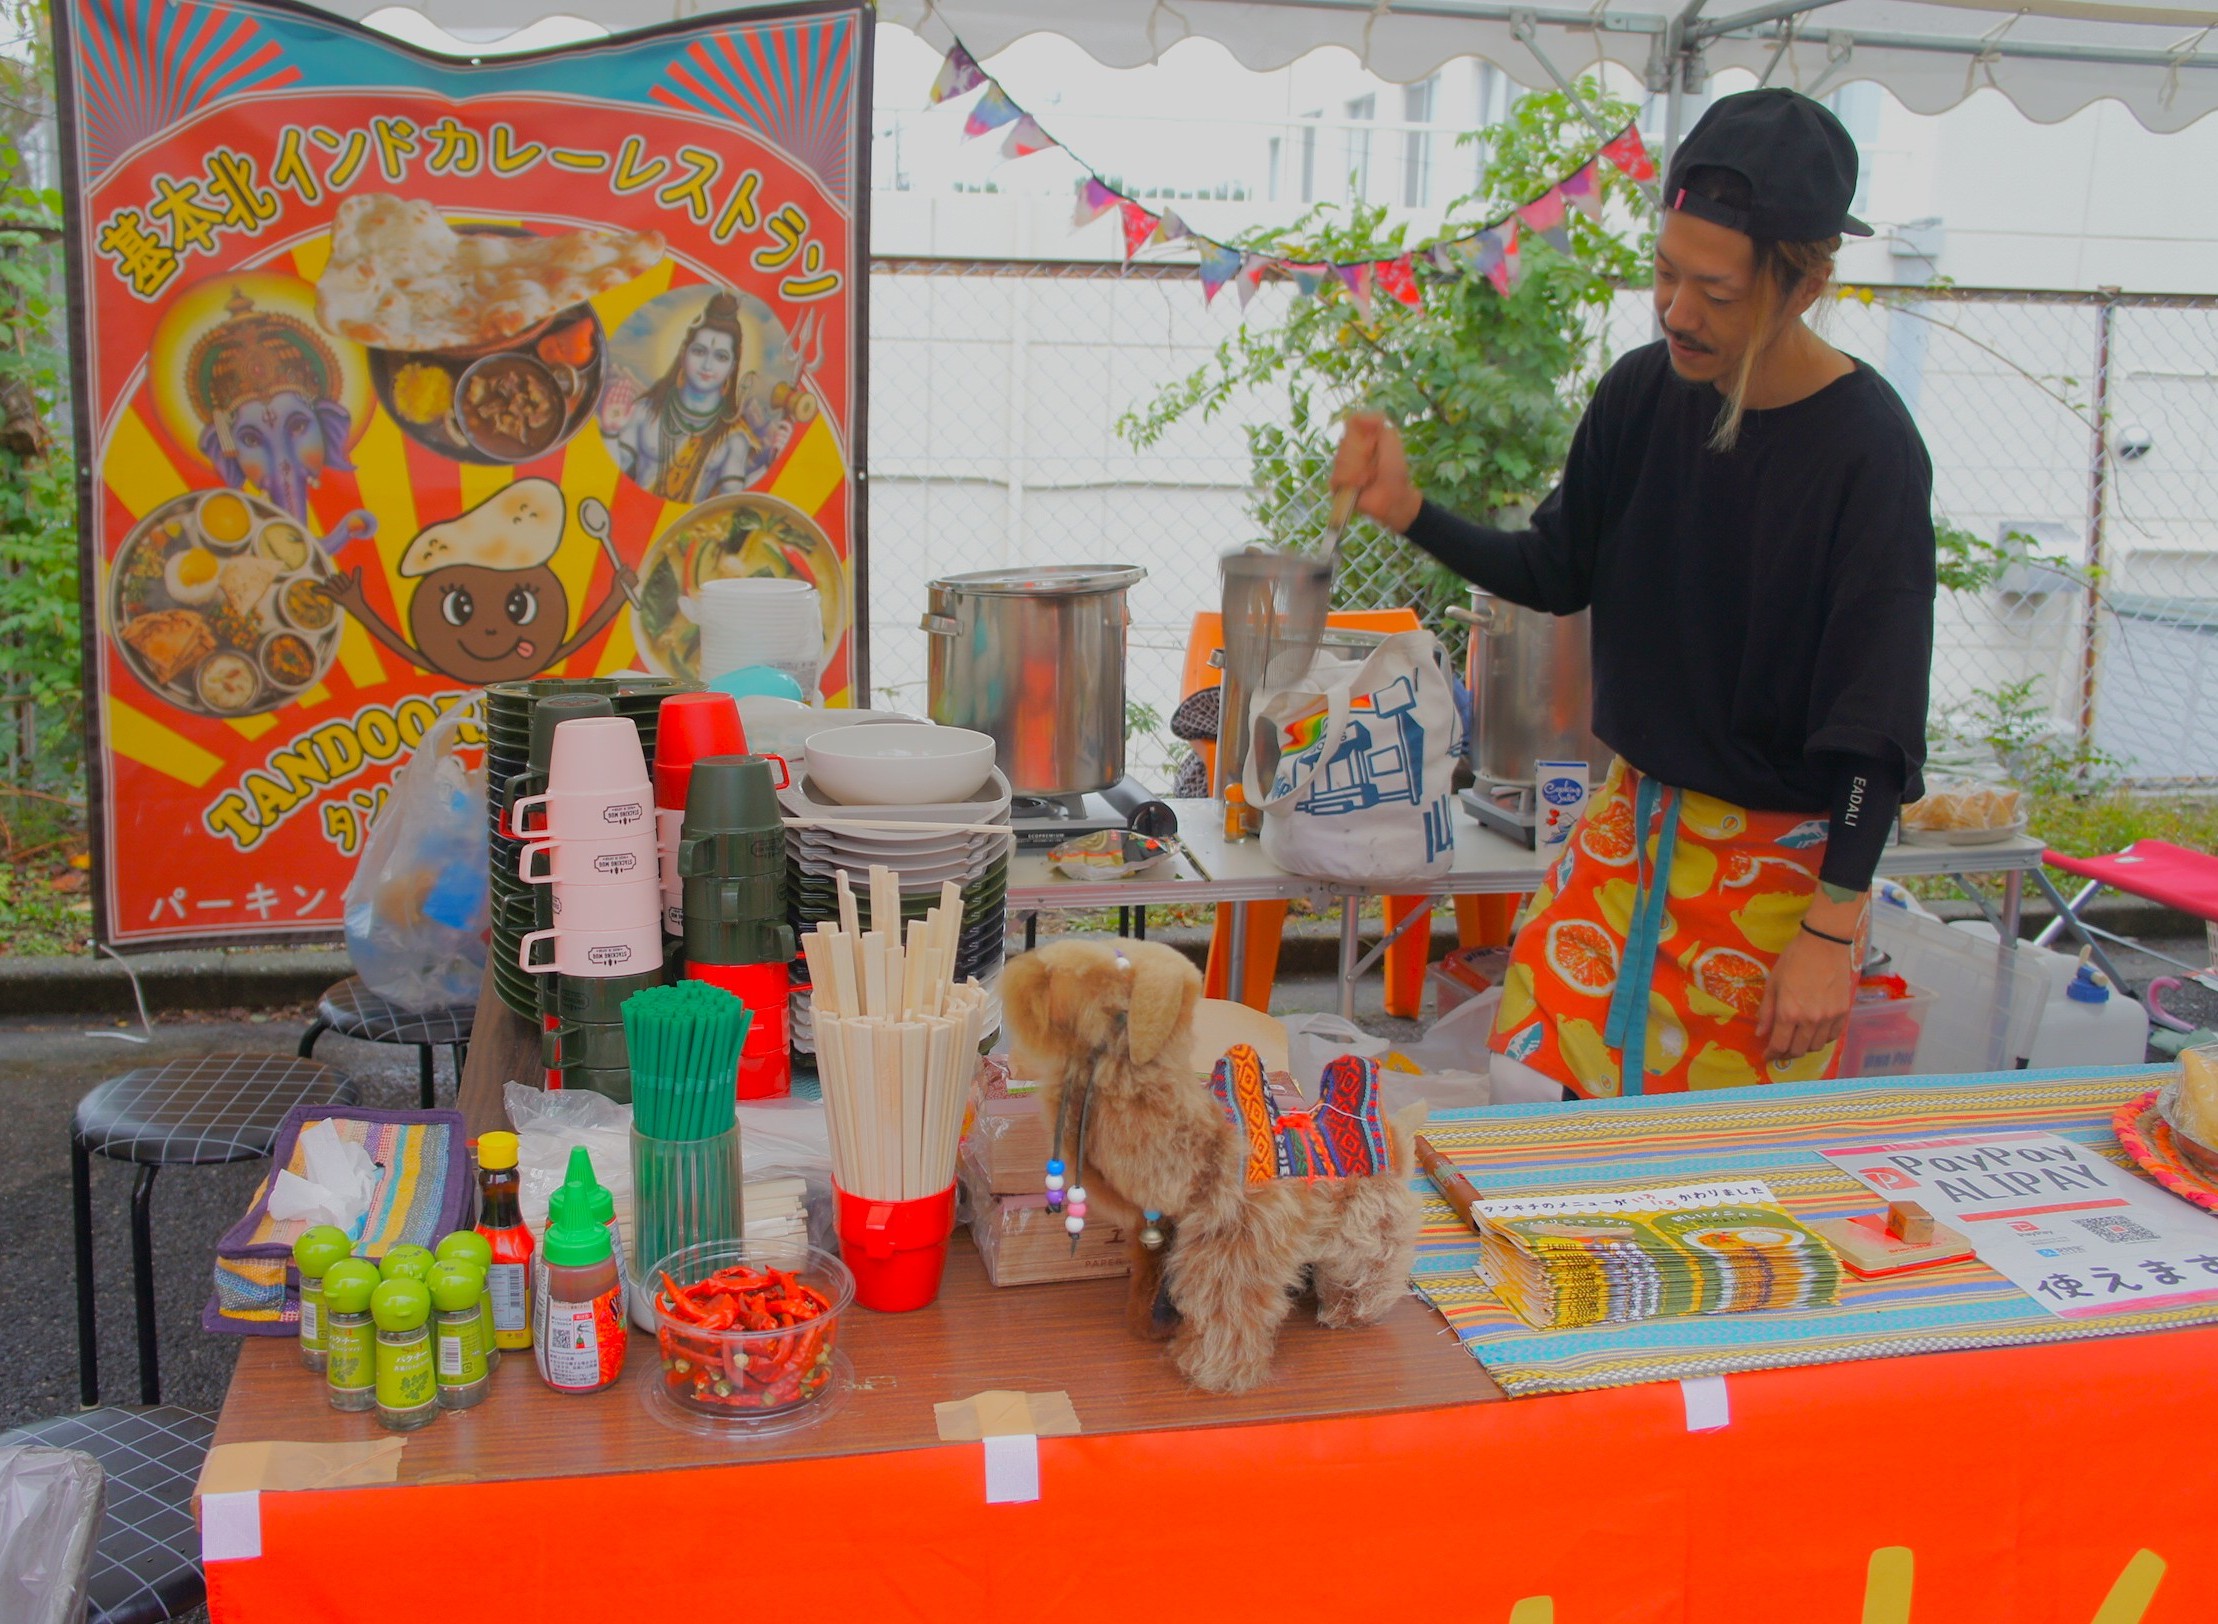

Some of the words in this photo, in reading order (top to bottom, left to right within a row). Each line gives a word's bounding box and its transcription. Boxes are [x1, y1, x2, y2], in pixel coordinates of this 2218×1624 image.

[99, 117, 840, 299] 基本北インドカレーレストラン
[205, 691, 487, 848] TANDOOR
[1844, 776, 1867, 827] EADALI
[149, 882, 344, 922] パーキン
[1887, 1145, 2078, 1177] PayPay
[1934, 1164, 2109, 1203] ALIPAY
